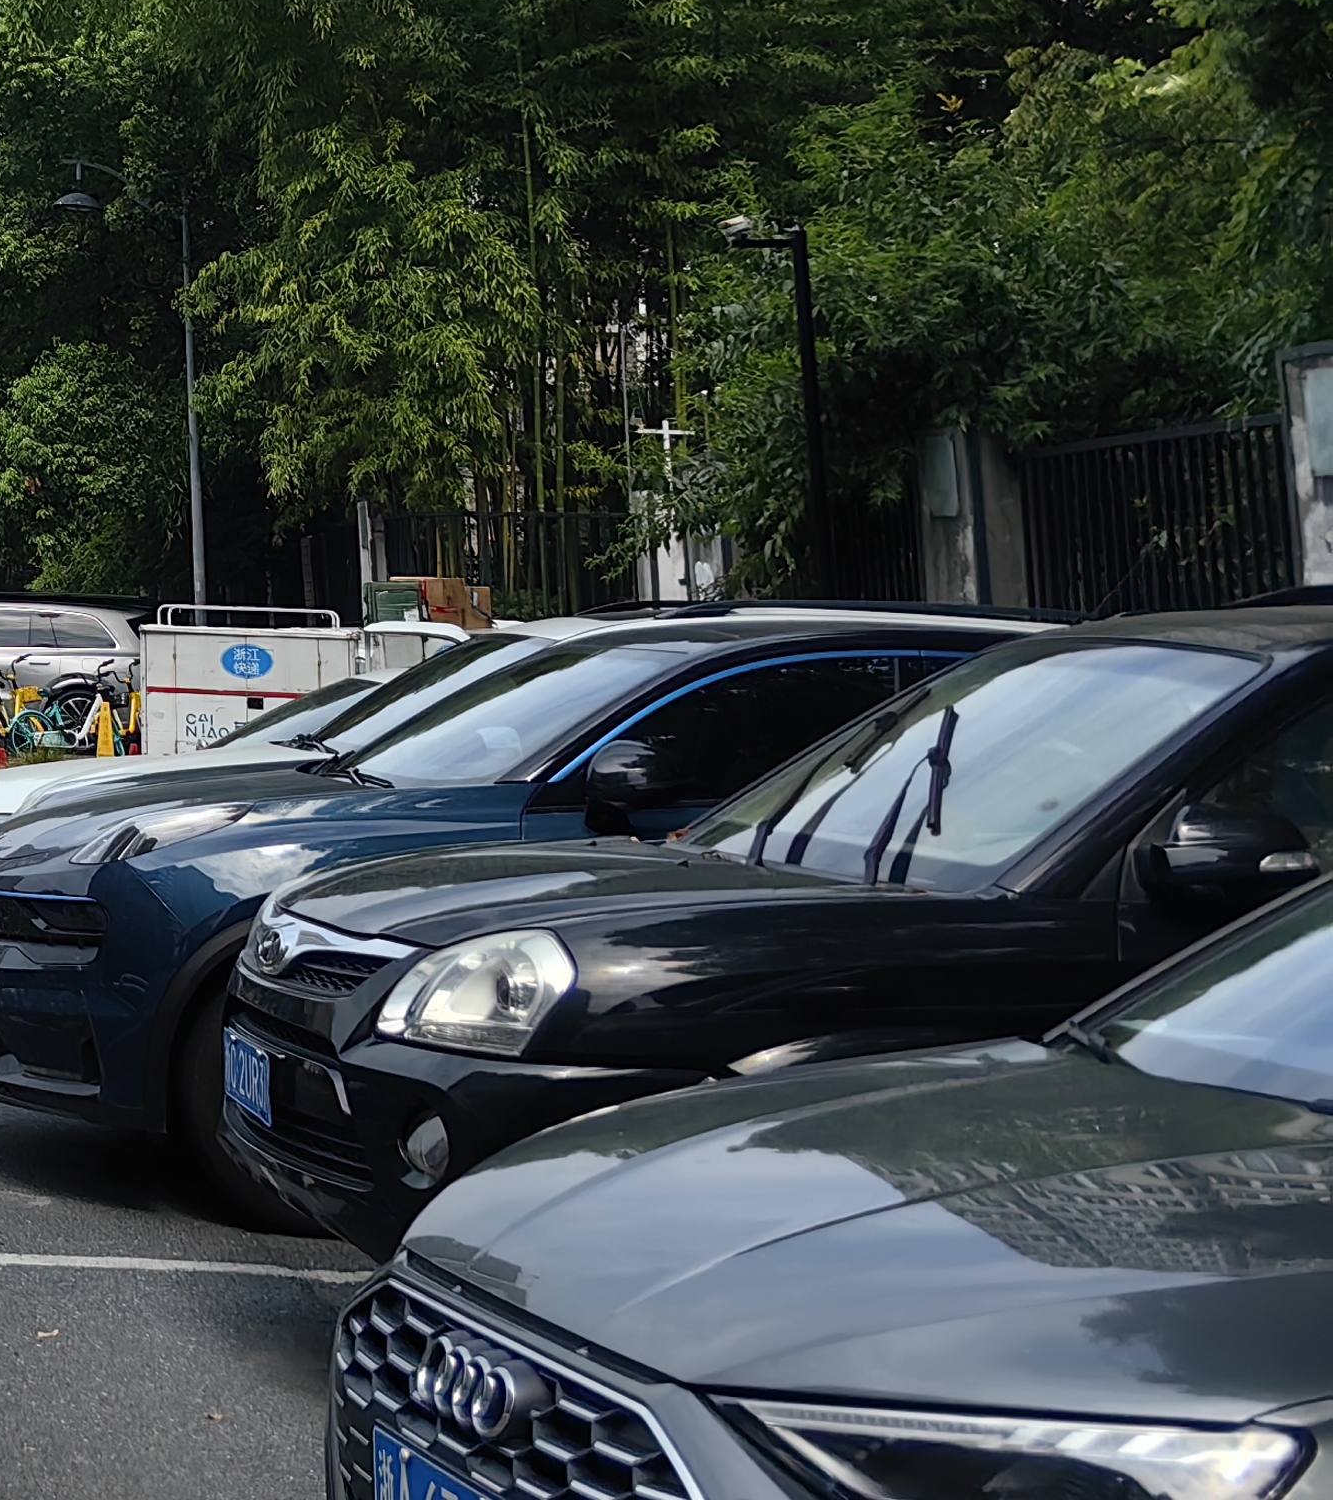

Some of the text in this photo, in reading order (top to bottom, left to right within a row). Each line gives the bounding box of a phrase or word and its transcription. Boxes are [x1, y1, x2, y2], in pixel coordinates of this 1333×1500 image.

[233, 647, 261, 661] 浙江
[233, 661, 260, 675] 快递
[186, 713, 213, 725] CAI
